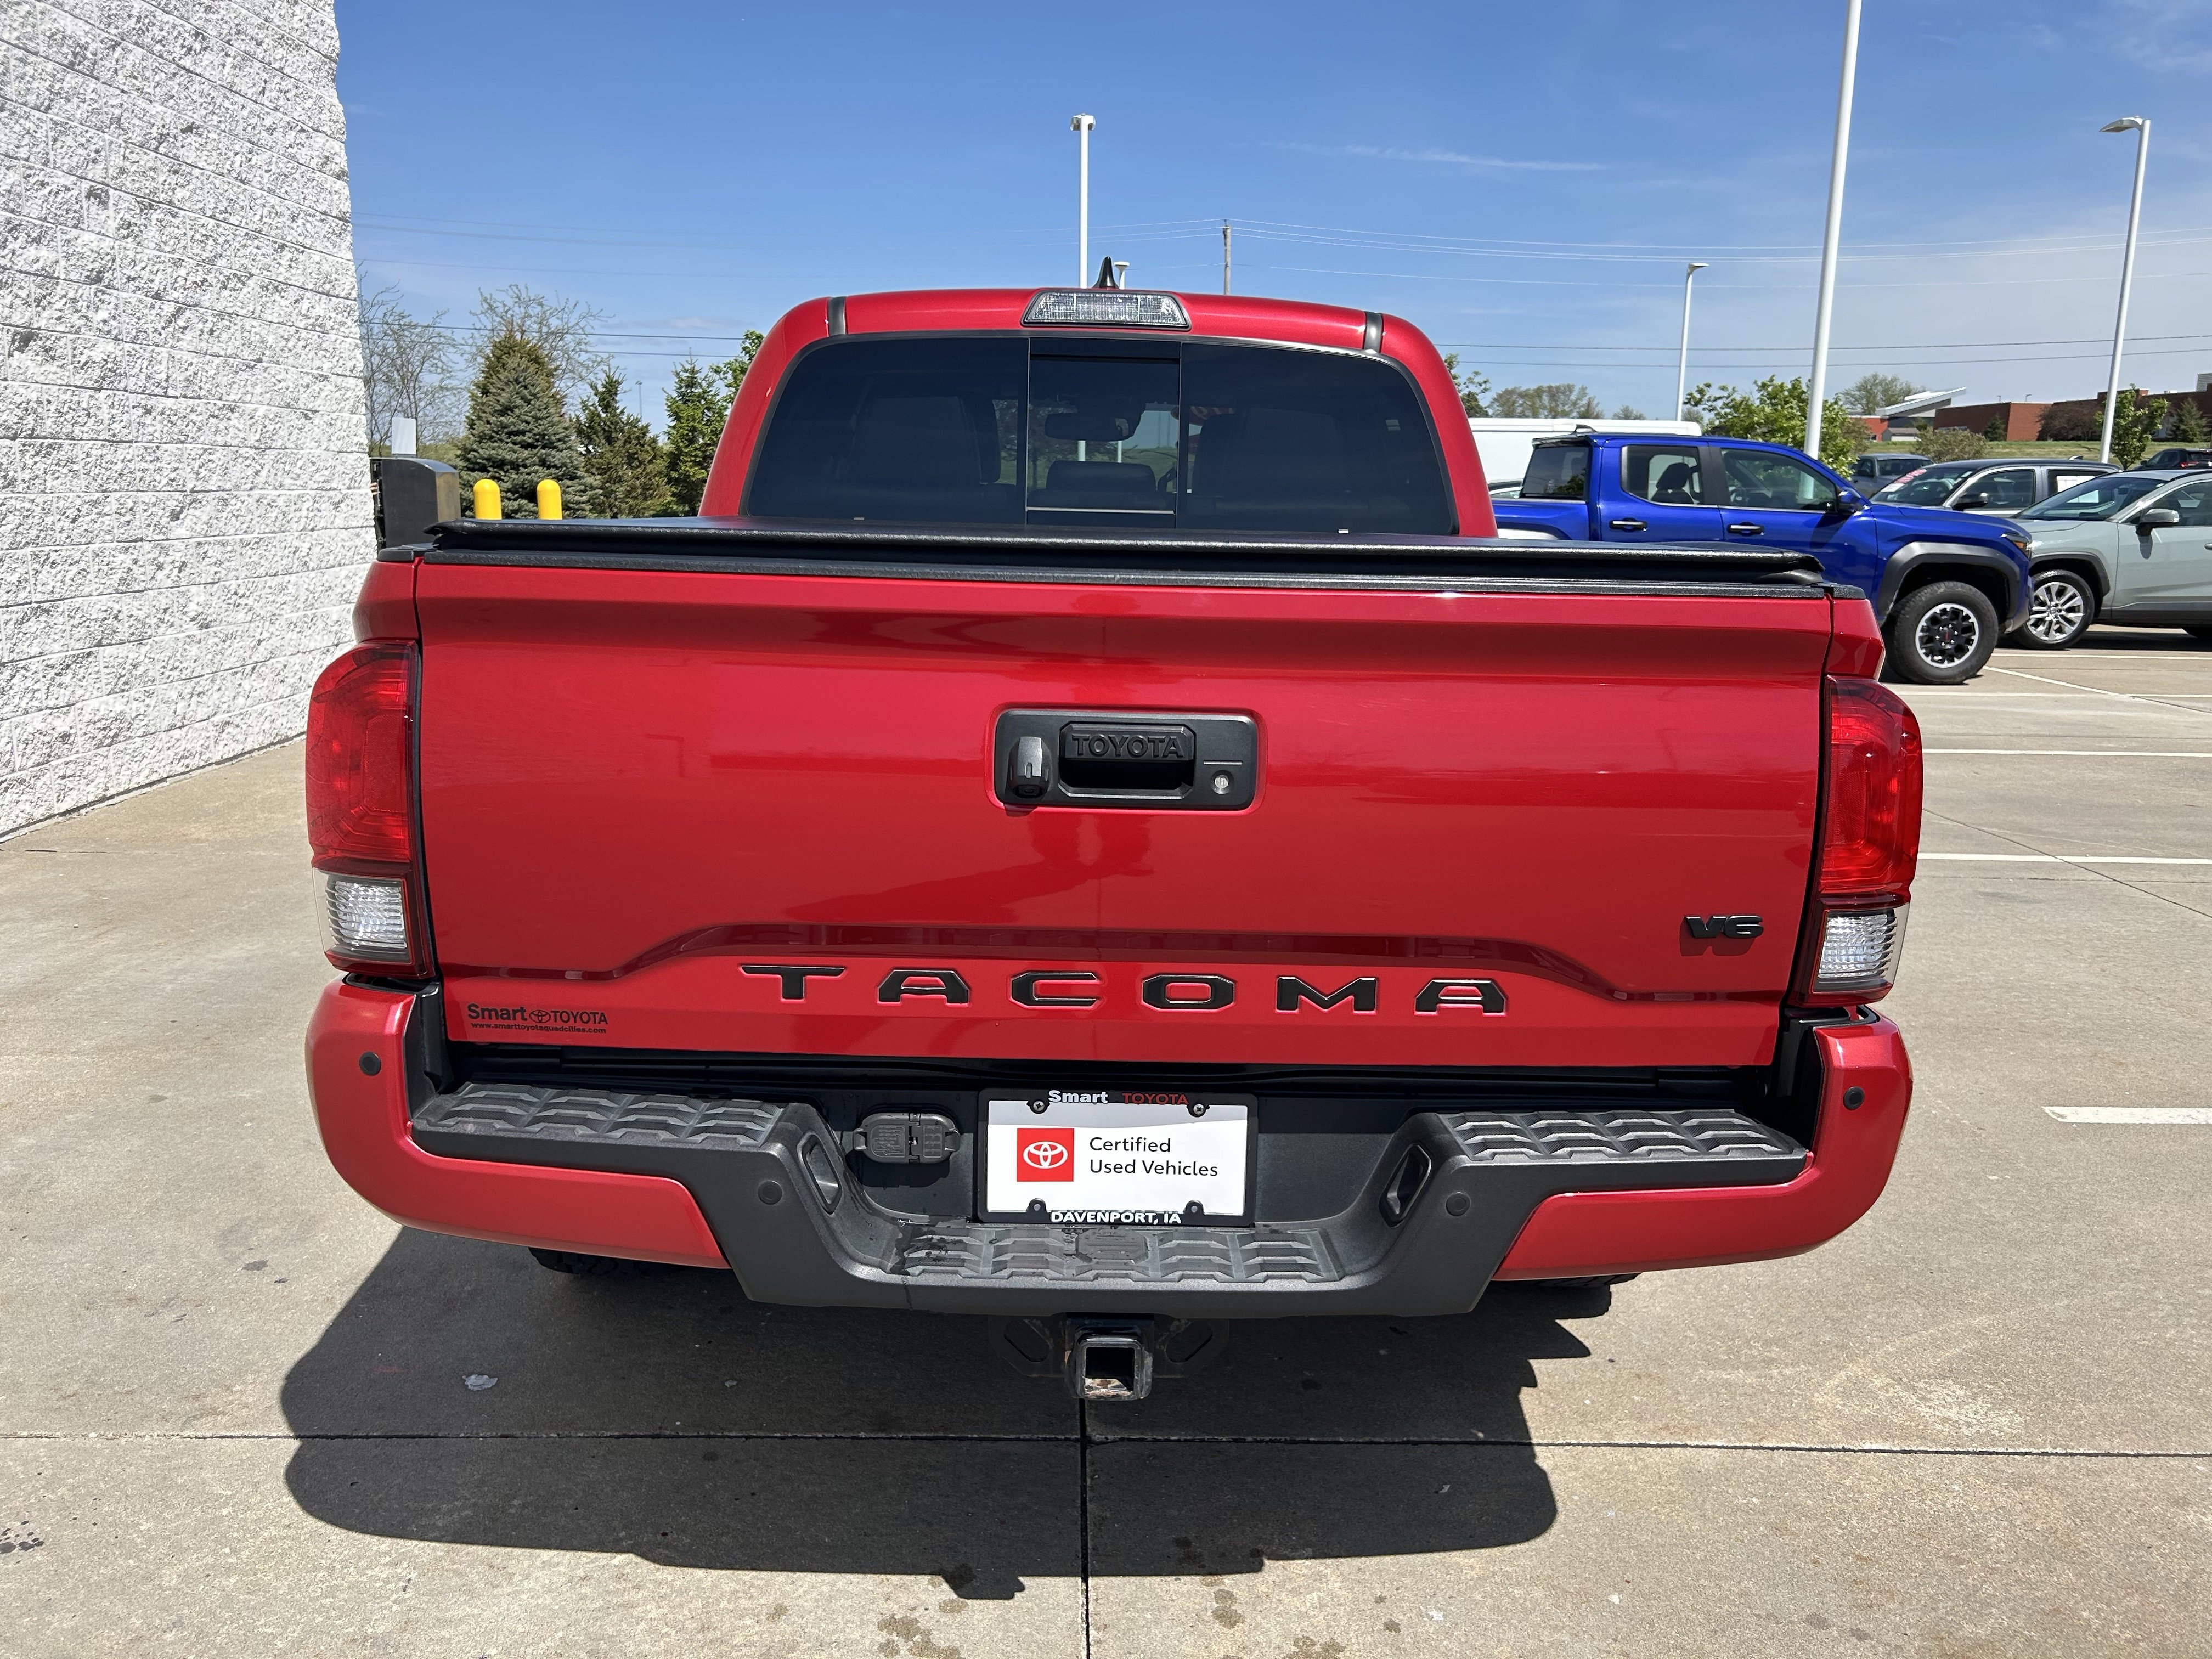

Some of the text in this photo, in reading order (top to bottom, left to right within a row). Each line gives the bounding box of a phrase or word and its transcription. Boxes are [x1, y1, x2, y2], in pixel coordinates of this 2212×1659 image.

[1071, 733, 1183, 758] TOYOTA
[1685, 915, 1764, 939] V6
[740, 964, 1505, 1013] TACOMA
[467, 1003, 608, 1024] Smart TOYOTA
[471, 1022, 606, 1033] www.smarttoyotaquadcities.com
[1048, 1090, 1189, 1105] Smart TOYOTA
[1090, 1137, 1171, 1152] Certified
[1090, 1159, 1218, 1176] Used Vehicles
[1051, 1211, 1182, 1224] DAVENPORT, IA
